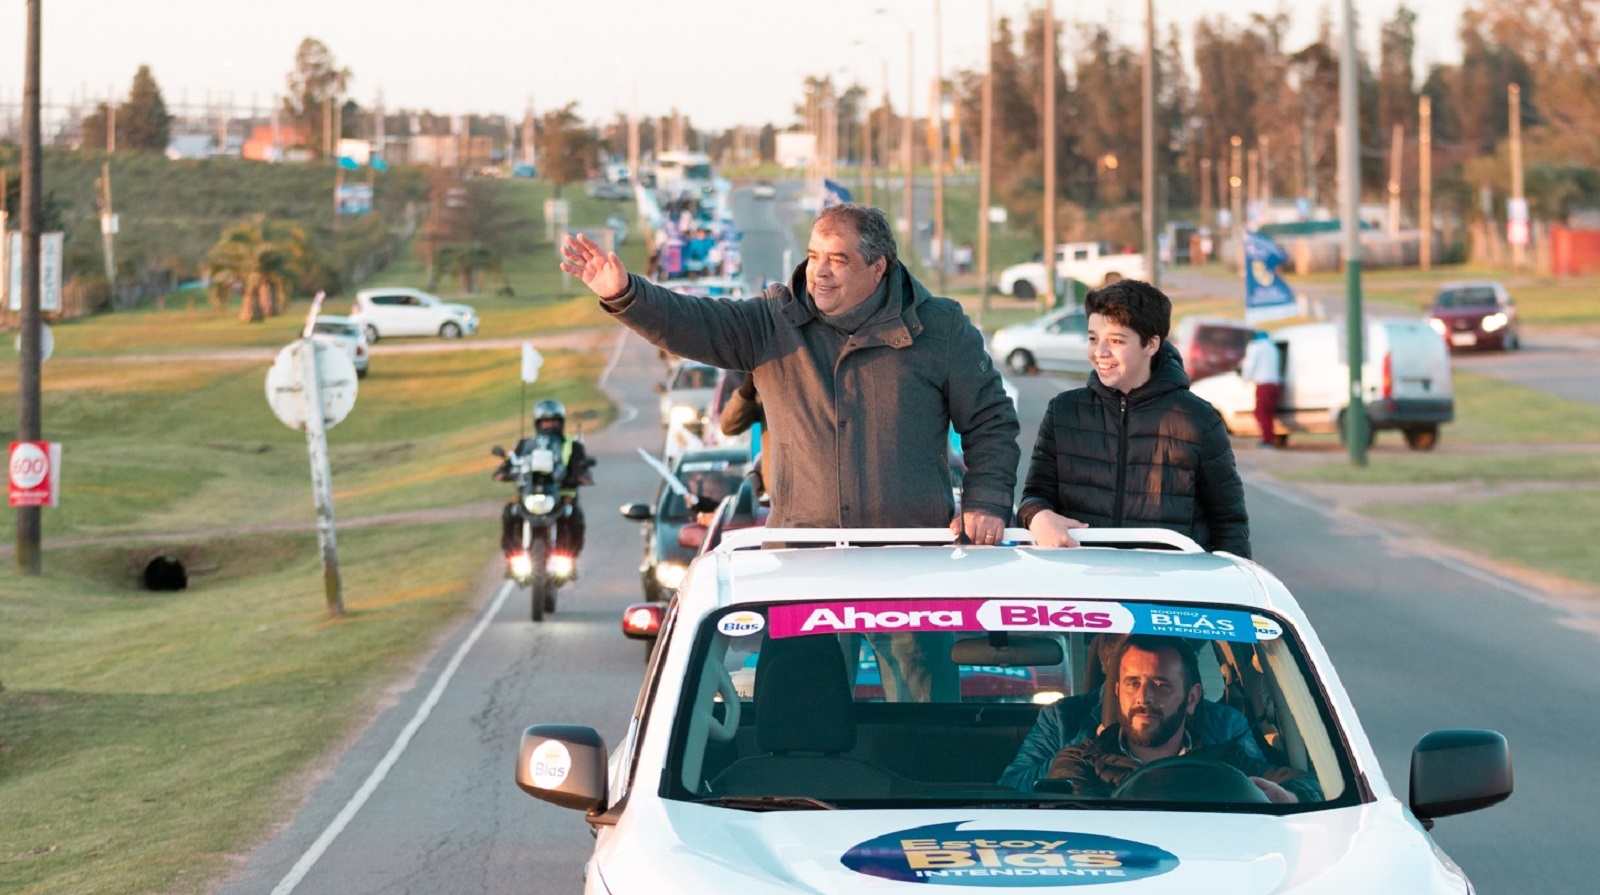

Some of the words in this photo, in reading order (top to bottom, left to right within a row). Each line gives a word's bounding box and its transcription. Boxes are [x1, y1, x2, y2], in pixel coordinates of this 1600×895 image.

[800, 606, 963, 631] Ahora
[1000, 605, 1112, 628] Blás
[1151, 614, 1235, 631] BLÁS
[1153, 625, 1236, 637] INTENDENTE
[535, 761, 565, 777] Blas
[900, 838, 1069, 850] Estoy
[915, 868, 1126, 877] INTENDENTE
